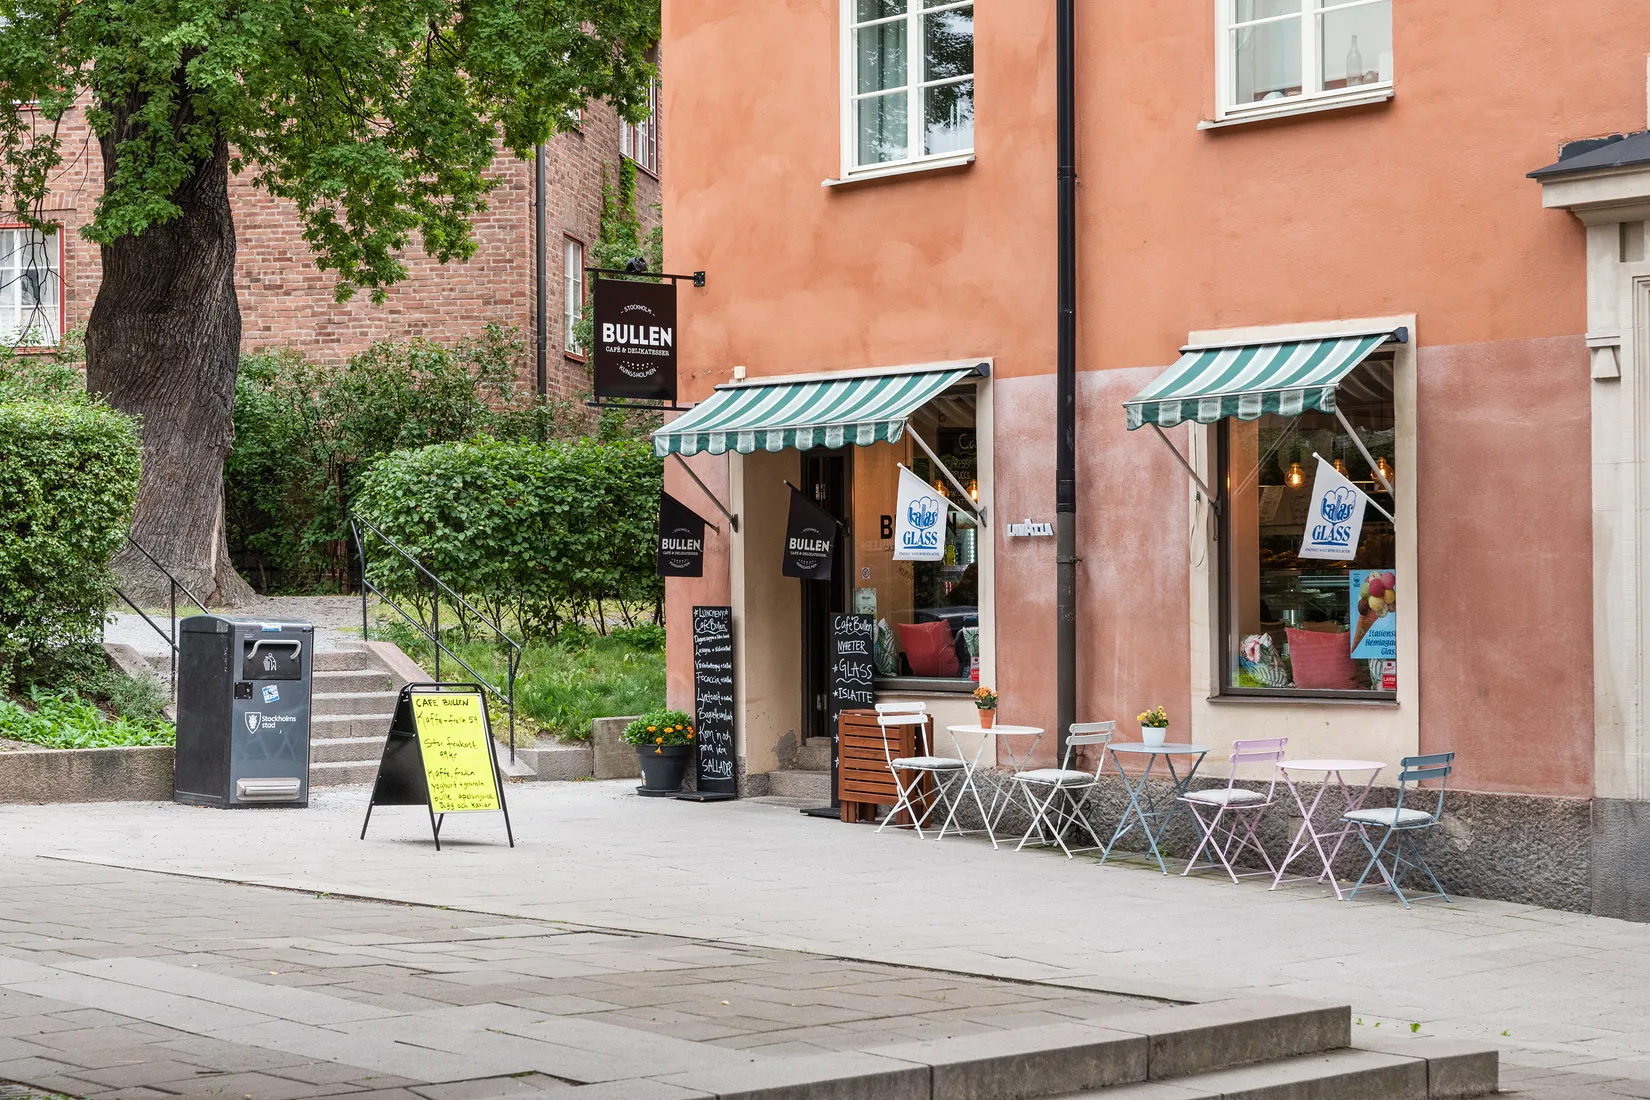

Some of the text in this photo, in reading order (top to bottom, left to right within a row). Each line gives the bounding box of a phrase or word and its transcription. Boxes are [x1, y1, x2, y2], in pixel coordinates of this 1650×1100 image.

[624, 304, 652, 314] STOCKHOLM
[602, 322, 672, 347] BULLEN
[628, 347, 670, 356] DELIKATESSER
[619, 364, 657, 378] KUNGSHOLMEN
[903, 530, 938, 546] GLASS
[1312, 524, 1352, 542] GLASS
[662, 538, 701, 551] BULLEN
[789, 538, 830, 552] BULLEN
[1380, 648, 1396, 656] Glas
[839, 658, 872, 680] GLASS
[442, 698, 468, 706] BULLEN
